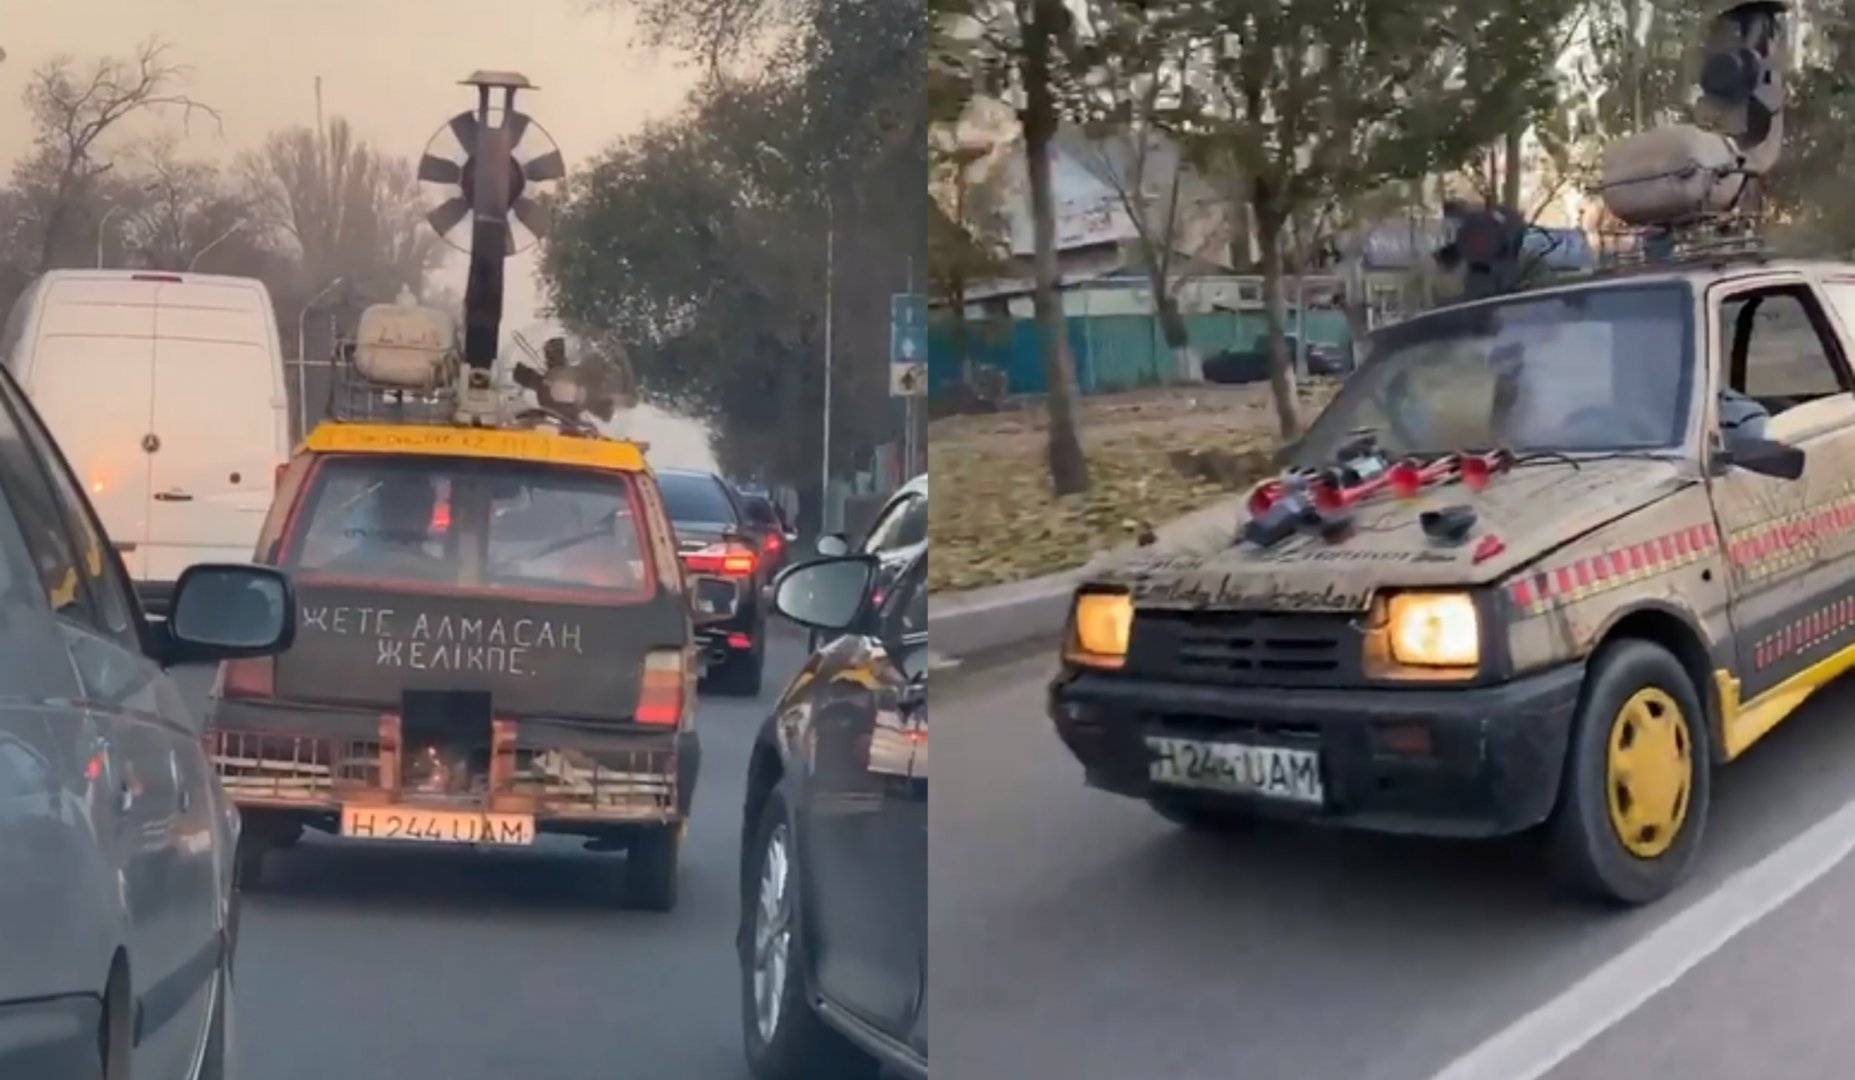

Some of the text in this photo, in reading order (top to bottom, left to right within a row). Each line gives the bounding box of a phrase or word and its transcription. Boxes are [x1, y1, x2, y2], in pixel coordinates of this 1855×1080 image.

[302, 606, 583, 655] ЖЕТЕ АЛМАСАҢ
[1241, 752, 1316, 796] UAM
[386, 815, 441, 840] 244
